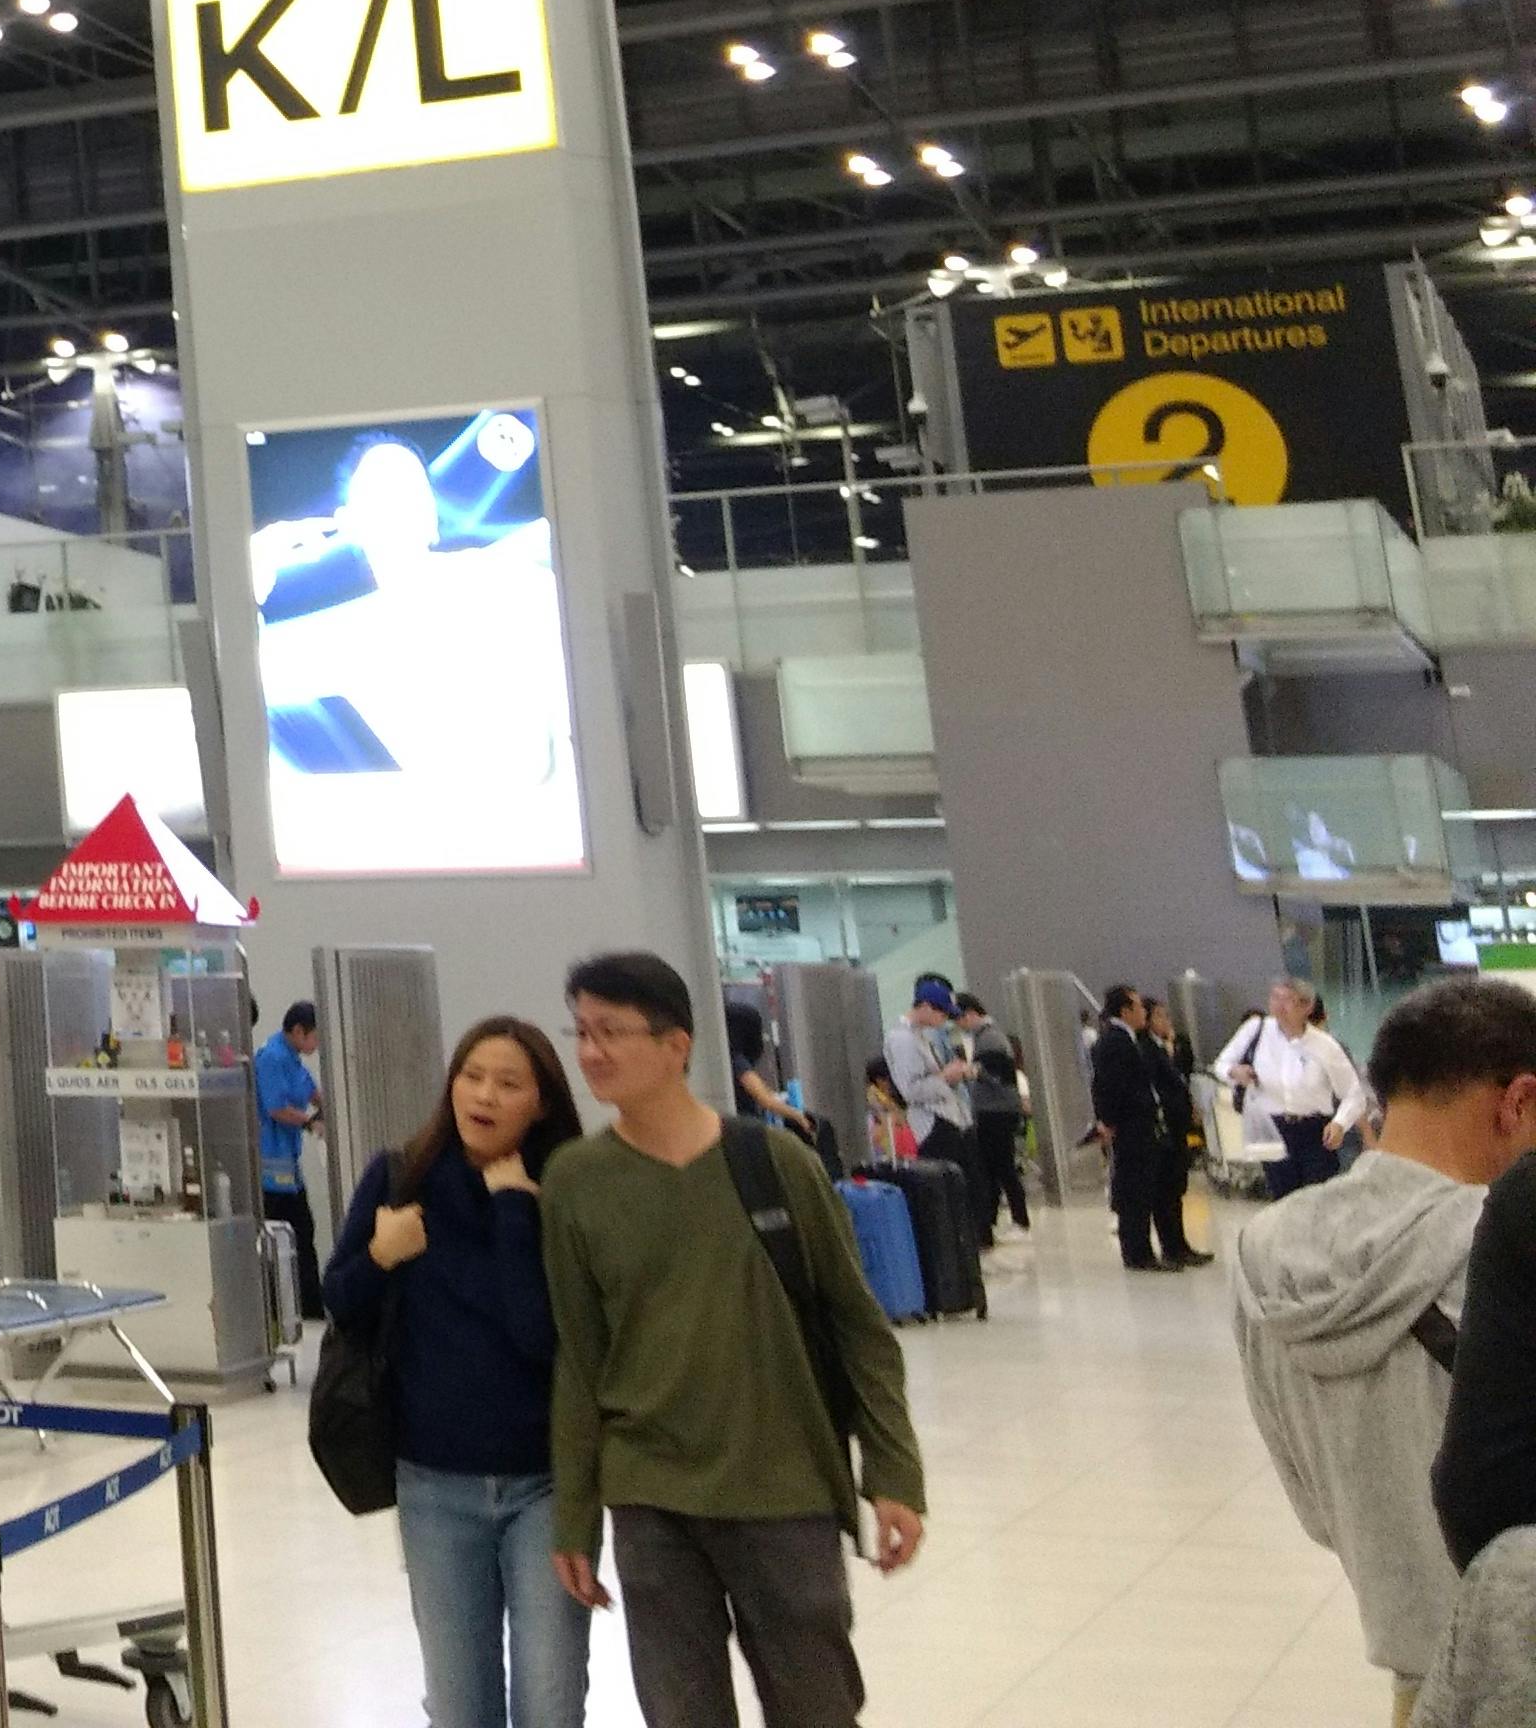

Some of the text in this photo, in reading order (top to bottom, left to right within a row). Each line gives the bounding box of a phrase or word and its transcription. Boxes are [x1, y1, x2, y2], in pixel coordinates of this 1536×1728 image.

[1140, 282, 1346, 324] International
[1143, 324, 1328, 360] Departures
[61, 862, 164, 878] IMPORTANT
[49, 877, 175, 893] INFORMATION
[38, 893, 177, 910] BEFORE CHECK IN
